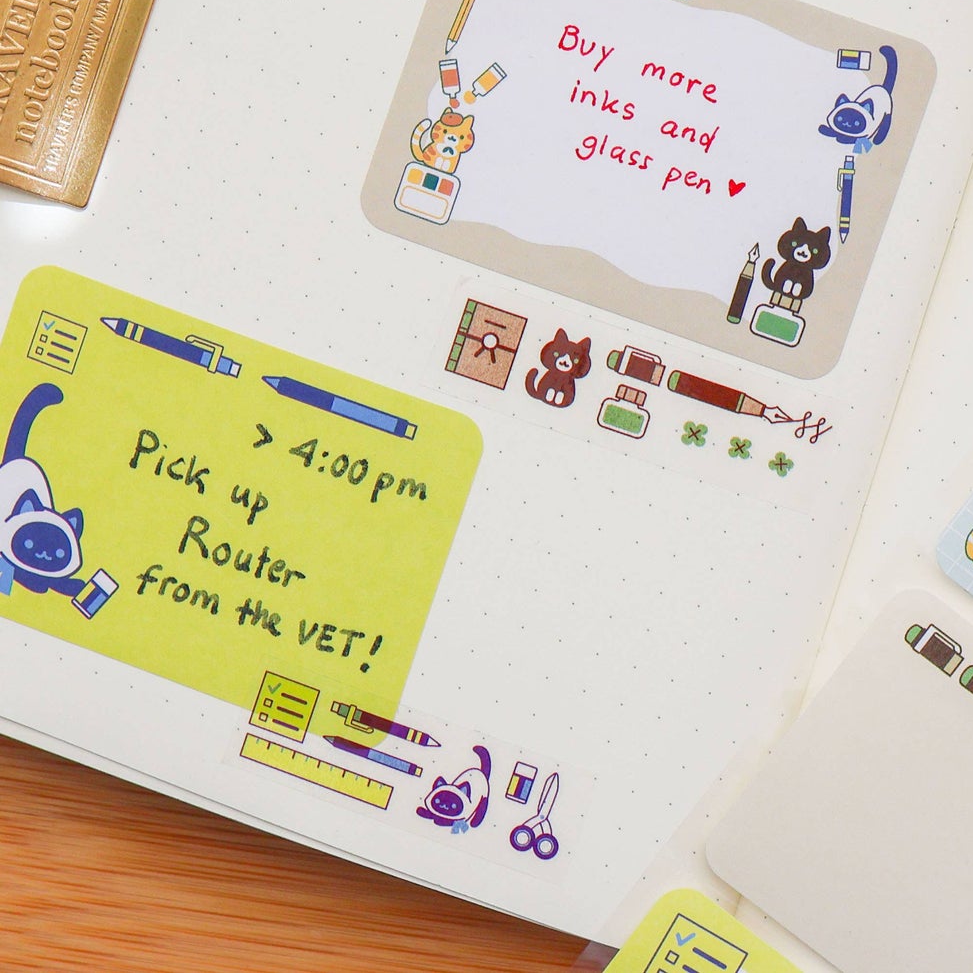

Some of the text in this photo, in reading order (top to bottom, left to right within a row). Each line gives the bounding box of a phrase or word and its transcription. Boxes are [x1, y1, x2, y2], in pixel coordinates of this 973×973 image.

[558, 25, 717, 103] Buy more
[45, 96, 80, 174] TRAVELER'S
[570, 80, 720, 153] inks and
[575, 134, 711, 194] glass pen
[129, 429, 269, 525] Pick up
[178, 515, 306, 587] Router
[137, 564, 382, 673] from the VET!
